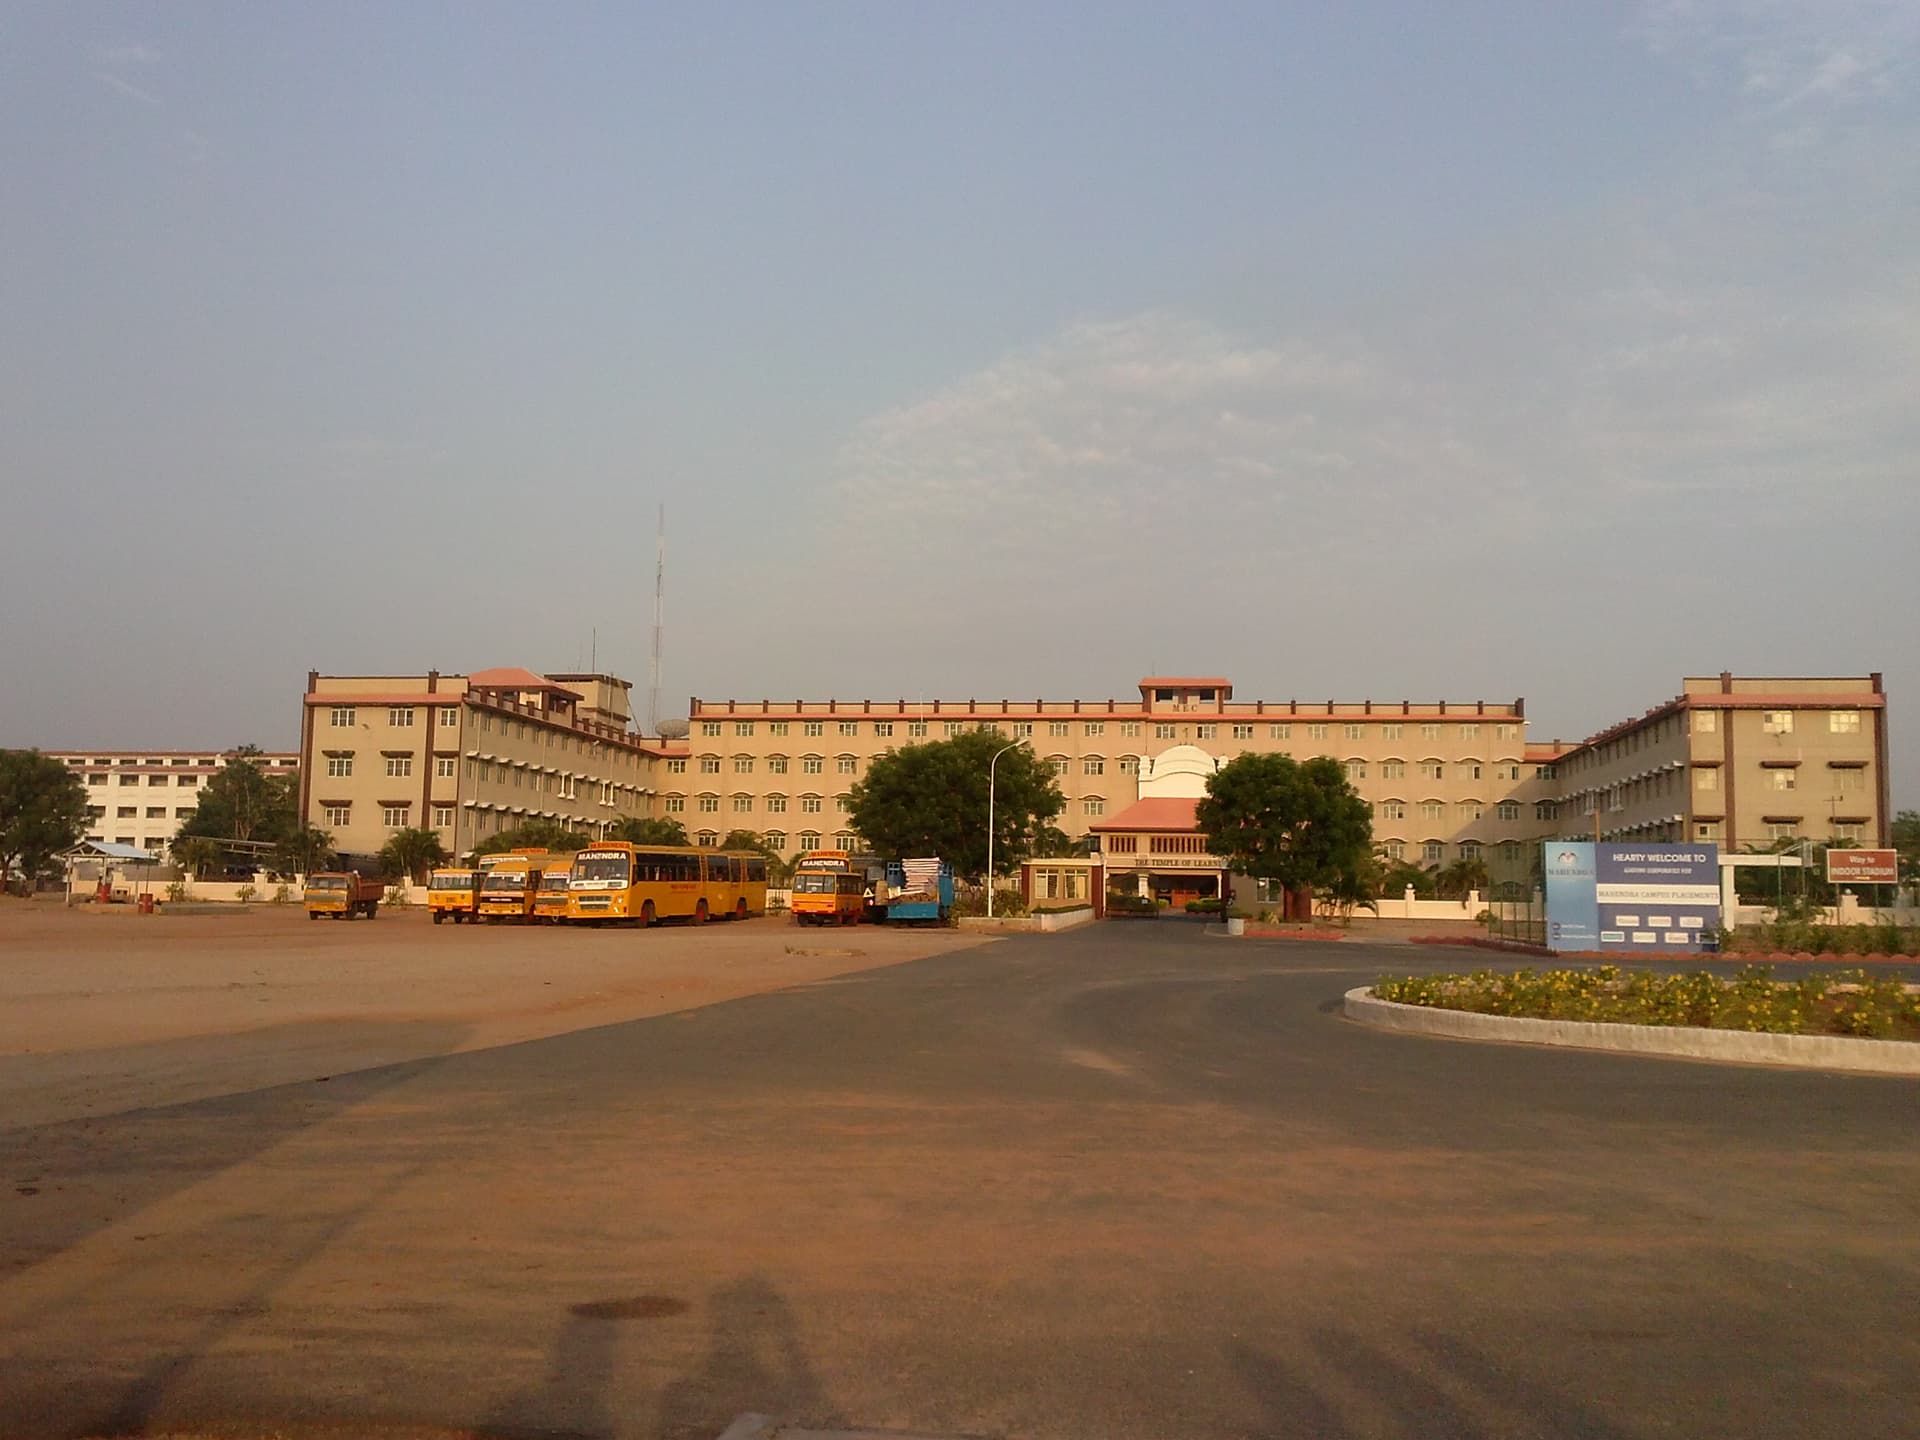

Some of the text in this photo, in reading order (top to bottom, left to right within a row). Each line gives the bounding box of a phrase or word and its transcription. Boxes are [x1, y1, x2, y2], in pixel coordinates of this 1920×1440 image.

[578, 852, 626, 860] MAHENDRA
[1612, 853, 1707, 862] HEARTY WELCOME TO
[1849, 855, 1866, 864] Way
[1136, 858, 1148, 867] THE
[1151, 858, 1178, 867] TEMPLE
[1181, 858, 1192, 867] OF
[1862, 867, 1894, 876] STADIUM
